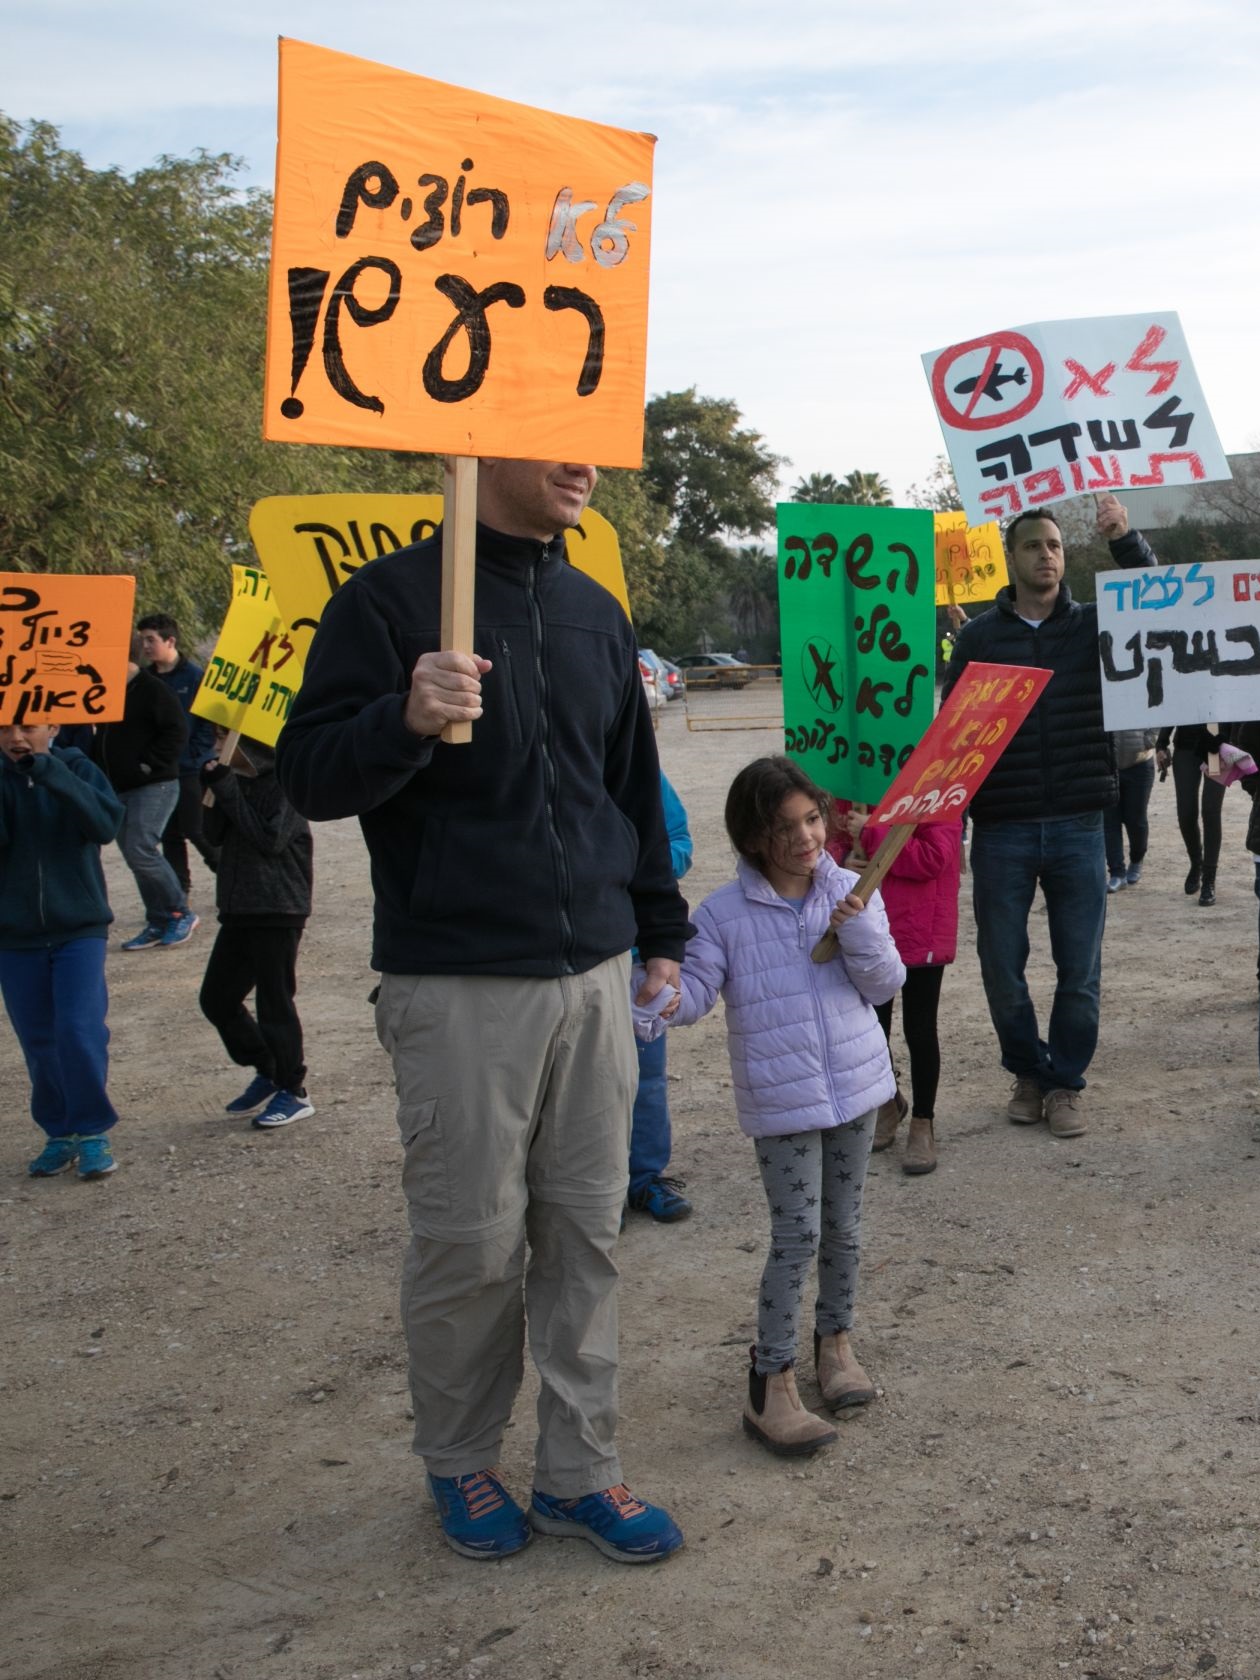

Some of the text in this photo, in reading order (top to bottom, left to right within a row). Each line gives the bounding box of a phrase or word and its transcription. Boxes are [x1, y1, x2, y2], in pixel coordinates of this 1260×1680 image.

[334, 157, 652, 269] לא רוצים
[280, 255, 606, 420] רעש!
[1059, 322, 1182, 402] לא
[975, 394, 1195, 482] לשדה
[977, 450, 1206, 519] תעופה
[783, 532, 920, 597] השדה
[1103, 563, 1216, 612] ללמוד
[248, 629, 295, 673] לא
[854, 603, 912, 662] שלי
[203, 656, 261, 705] תעופה
[855, 663, 929, 718] לא
[784, 717, 850, 765] תעופה
[911, 749, 985, 795] חלום
